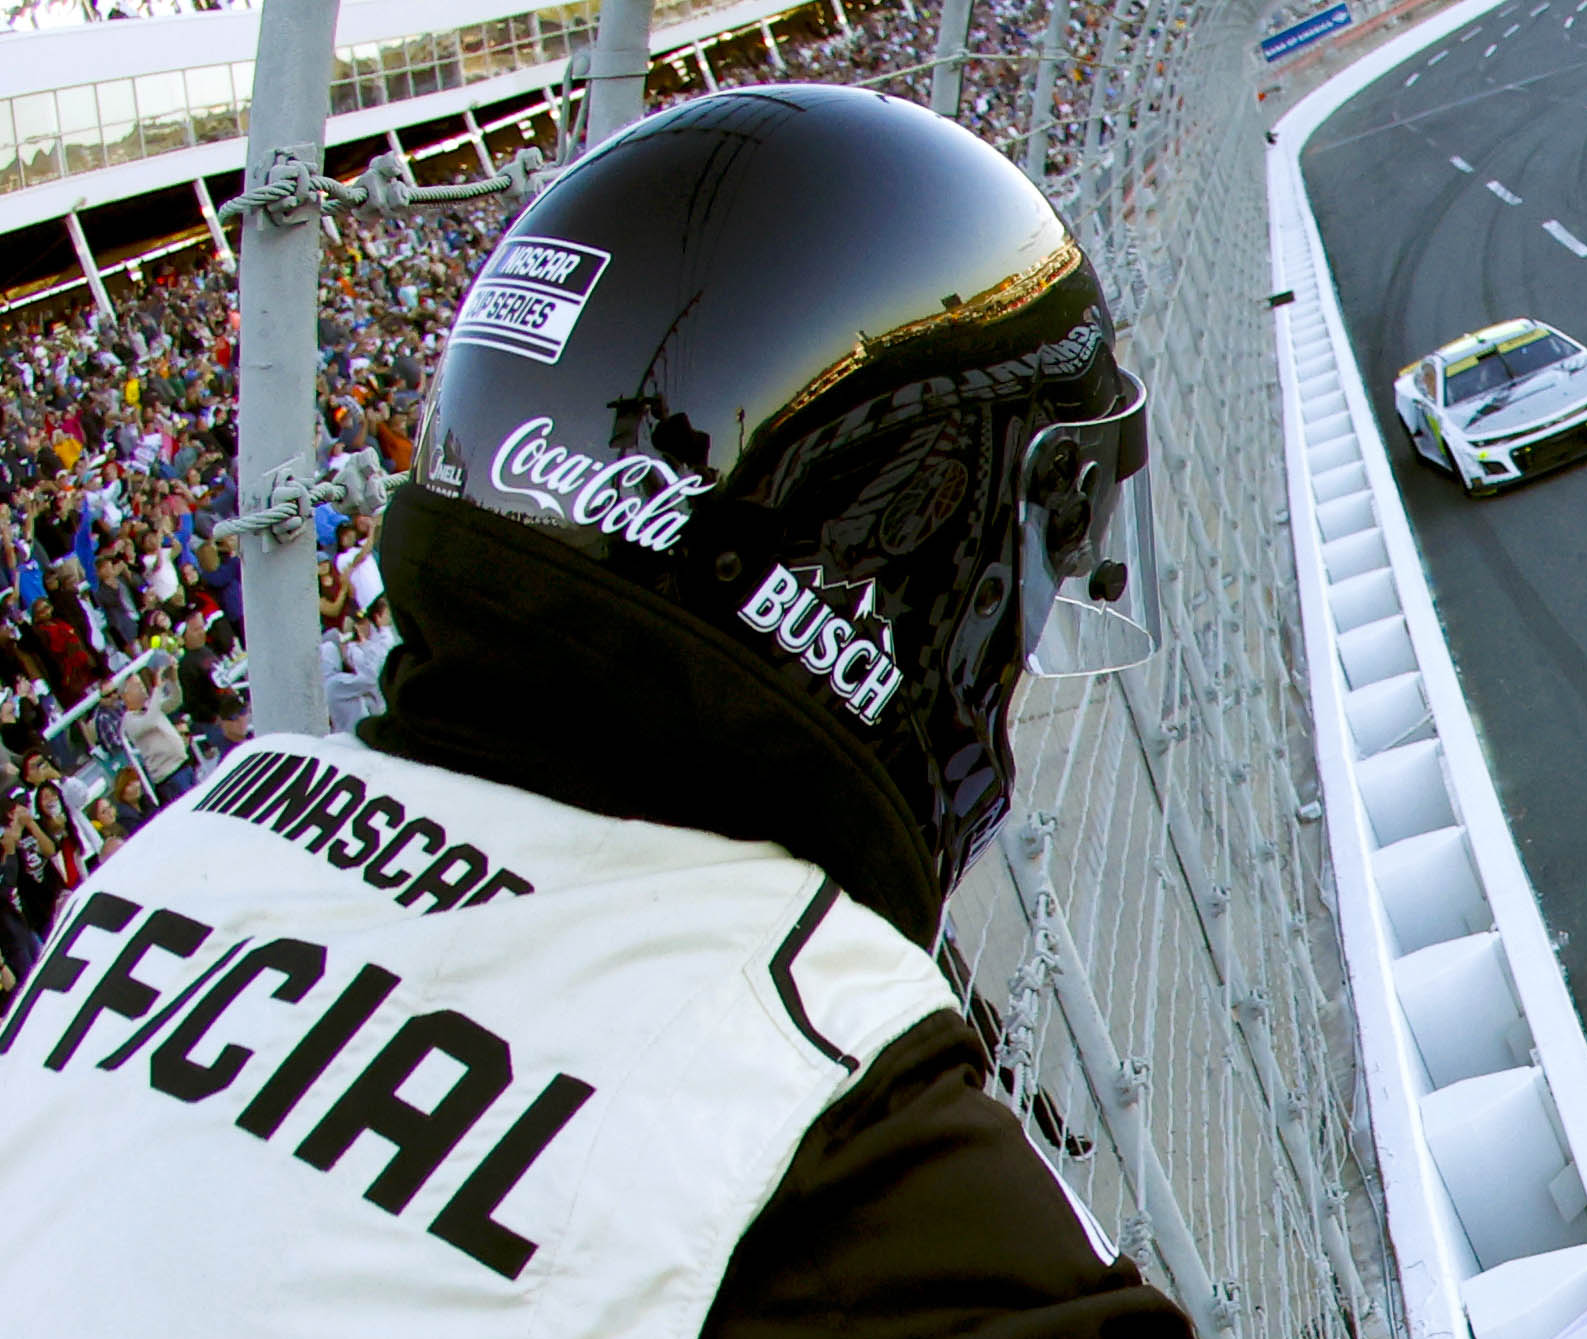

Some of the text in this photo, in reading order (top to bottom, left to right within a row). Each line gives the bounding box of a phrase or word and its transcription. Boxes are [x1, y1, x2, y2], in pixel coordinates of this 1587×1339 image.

[486, 292, 557, 330] SERIES
[501, 246, 581, 284] NASCAR
[491, 417, 717, 552] Coca-Cola
[737, 563, 904, 726] BUSCH
[0, 891, 597, 1281] FFICIAL
